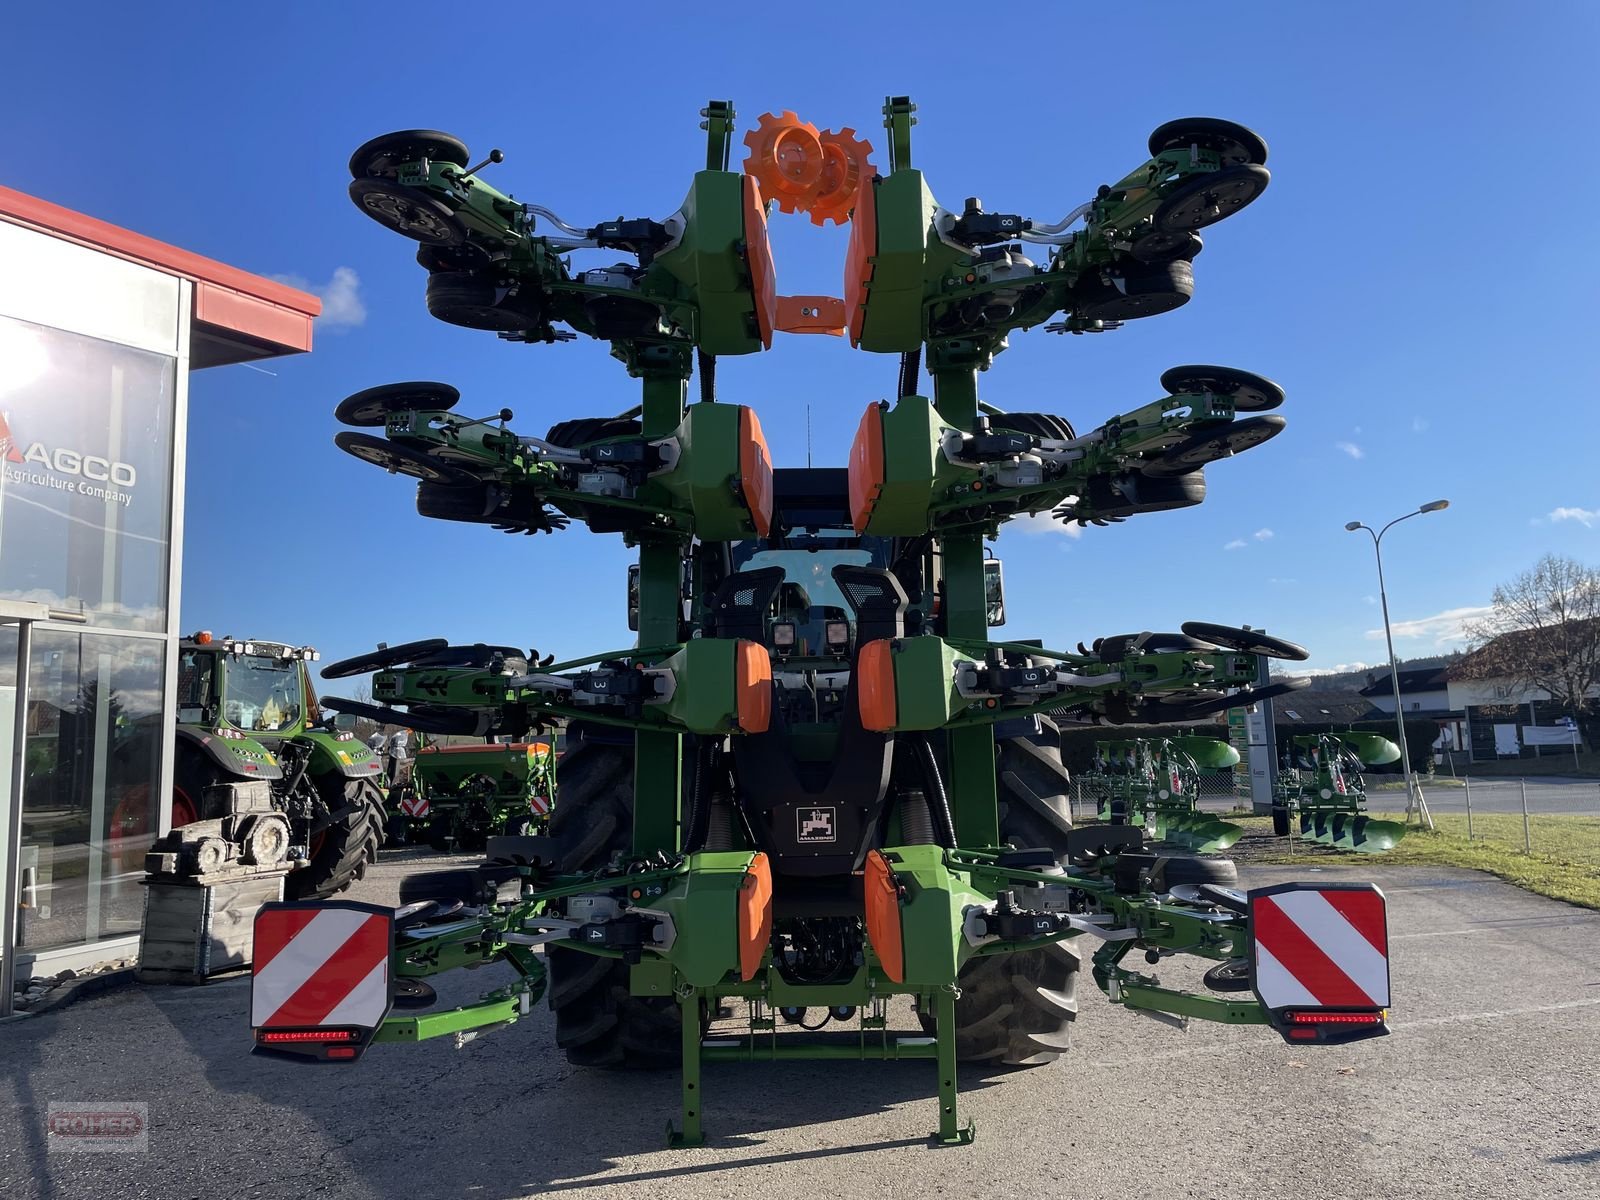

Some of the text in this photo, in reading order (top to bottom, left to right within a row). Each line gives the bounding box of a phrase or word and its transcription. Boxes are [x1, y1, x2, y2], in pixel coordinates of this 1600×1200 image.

[1001, 218, 1014, 226] 8
[1010, 439, 1023, 447] 7
[599, 449, 612, 457] 2
[24, 442, 136, 488] AGCO
[5, 466, 133, 506] Agriculture Company
[1025, 673, 1038, 681] 6
[594, 681, 606, 689] 3
[1037, 921, 1050, 929] 5
[590, 930, 603, 939] 4
